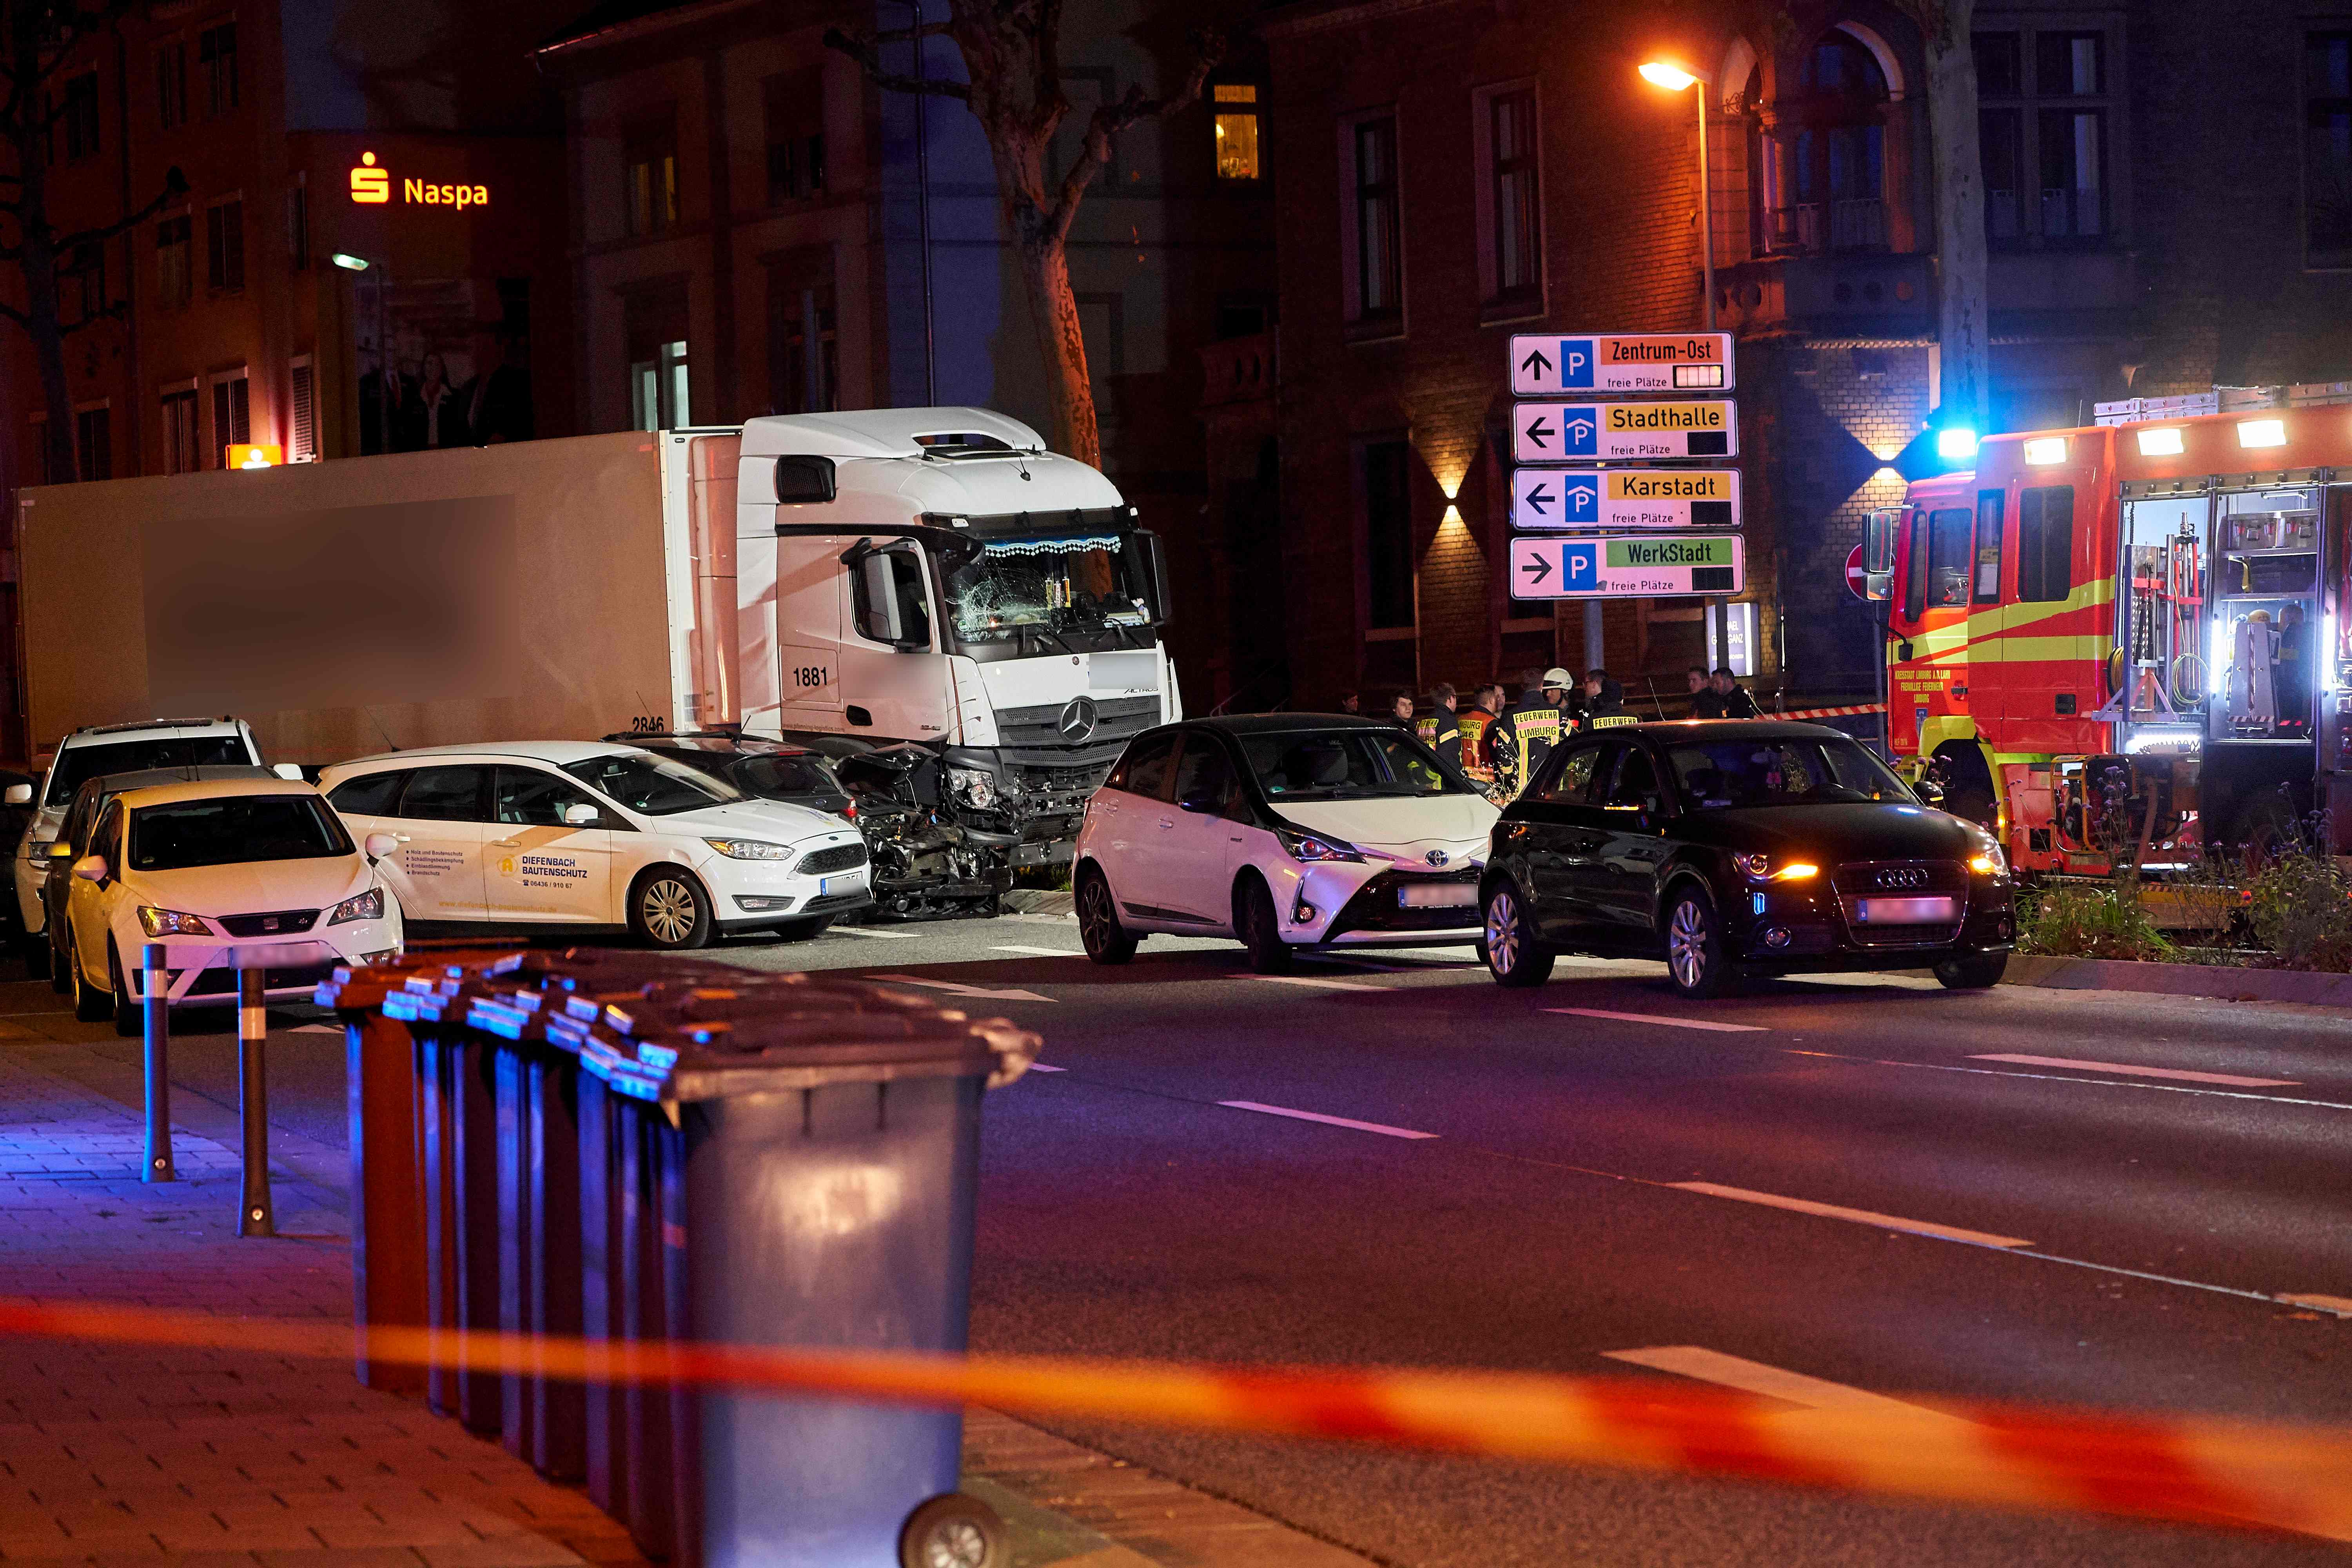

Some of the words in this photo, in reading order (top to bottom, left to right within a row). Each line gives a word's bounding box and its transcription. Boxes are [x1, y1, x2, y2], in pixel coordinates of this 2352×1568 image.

[405, 179, 488, 211] Naspa
[1612, 340, 1711, 361] Zentrum-Ost
[1608, 378, 1631, 388] freie
[1636, 377, 1667, 387] Plätze
[1613, 408, 1719, 428] Stadthalle
[1611, 446, 1634, 455] freie
[1639, 445, 1670, 454] Plätze
[1623, 477, 1715, 495] Karstadt
[1612, 513, 1636, 523] freie
[1642, 513, 1673, 523] Plätze
[1628, 544, 1712, 563] WerkStadt
[1612, 581, 1636, 591] freie
[1641, 581, 1673, 590] Plätze
[793, 666, 827, 686] 1881
[1515, 710, 1557, 723] FEUERWEHR
[1595, 717, 1637, 728] FEUERWEHR
[633, 716, 664, 733] 2846
[1519, 726, 1556, 738] LIMBURG
[522, 856, 575, 867] DIEFENBACH
[522, 866, 588, 878] BAUTENSCHUTZ
